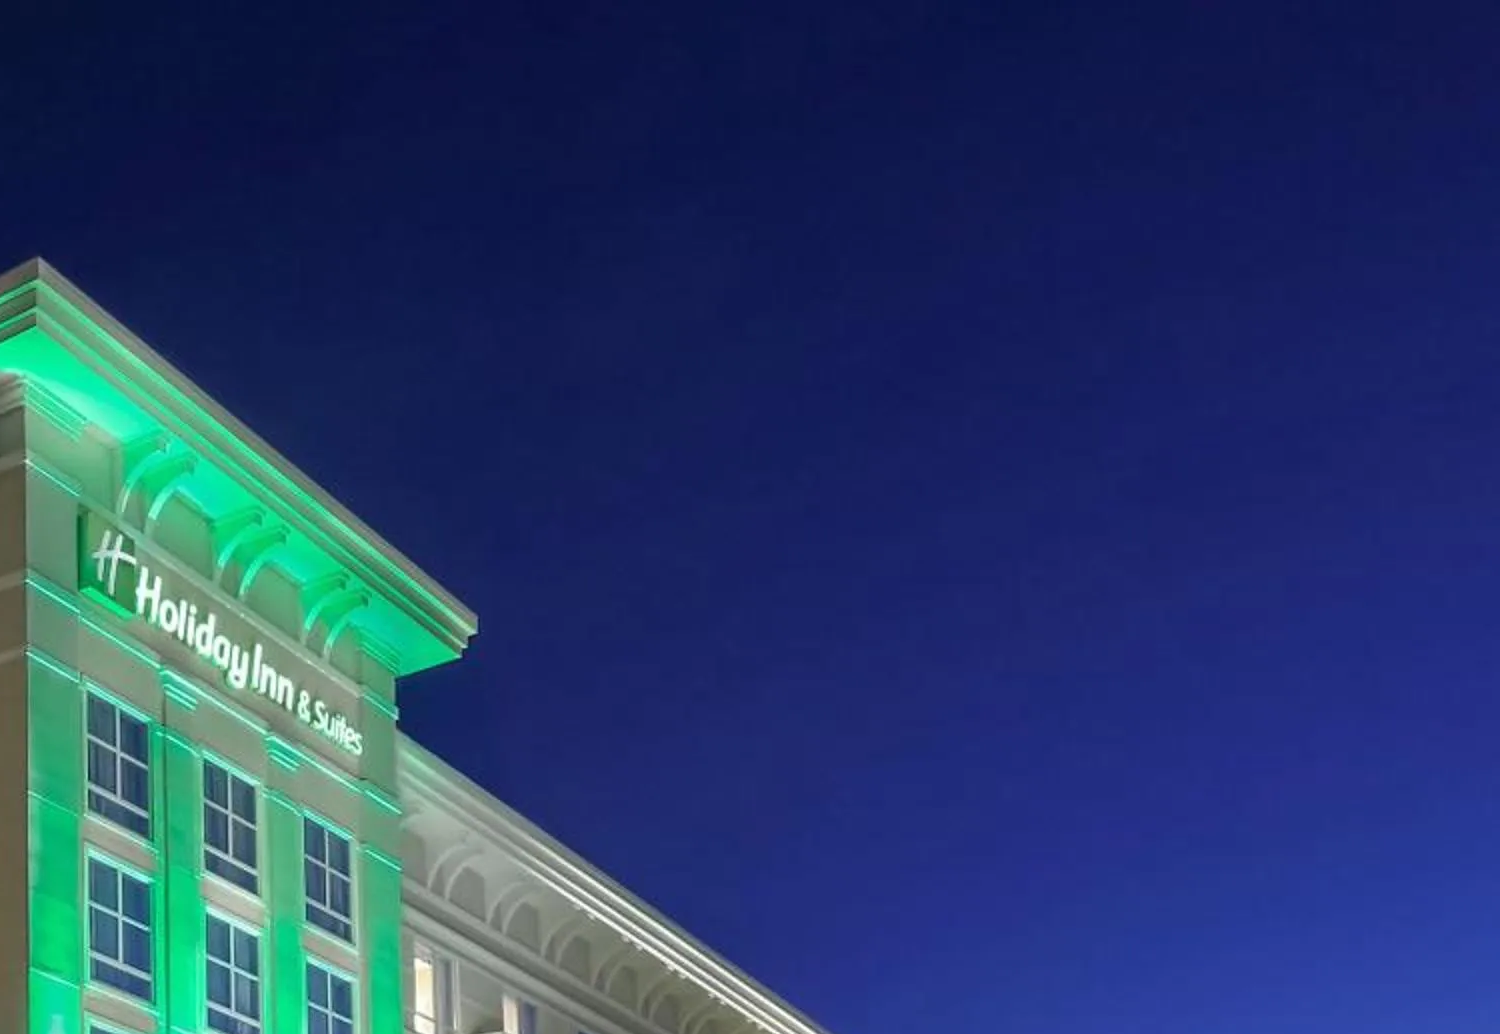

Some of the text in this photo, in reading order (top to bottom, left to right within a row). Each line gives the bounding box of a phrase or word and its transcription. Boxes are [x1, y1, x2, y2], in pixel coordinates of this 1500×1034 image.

[135, 566, 364, 756] Holiday Inn & Suites
